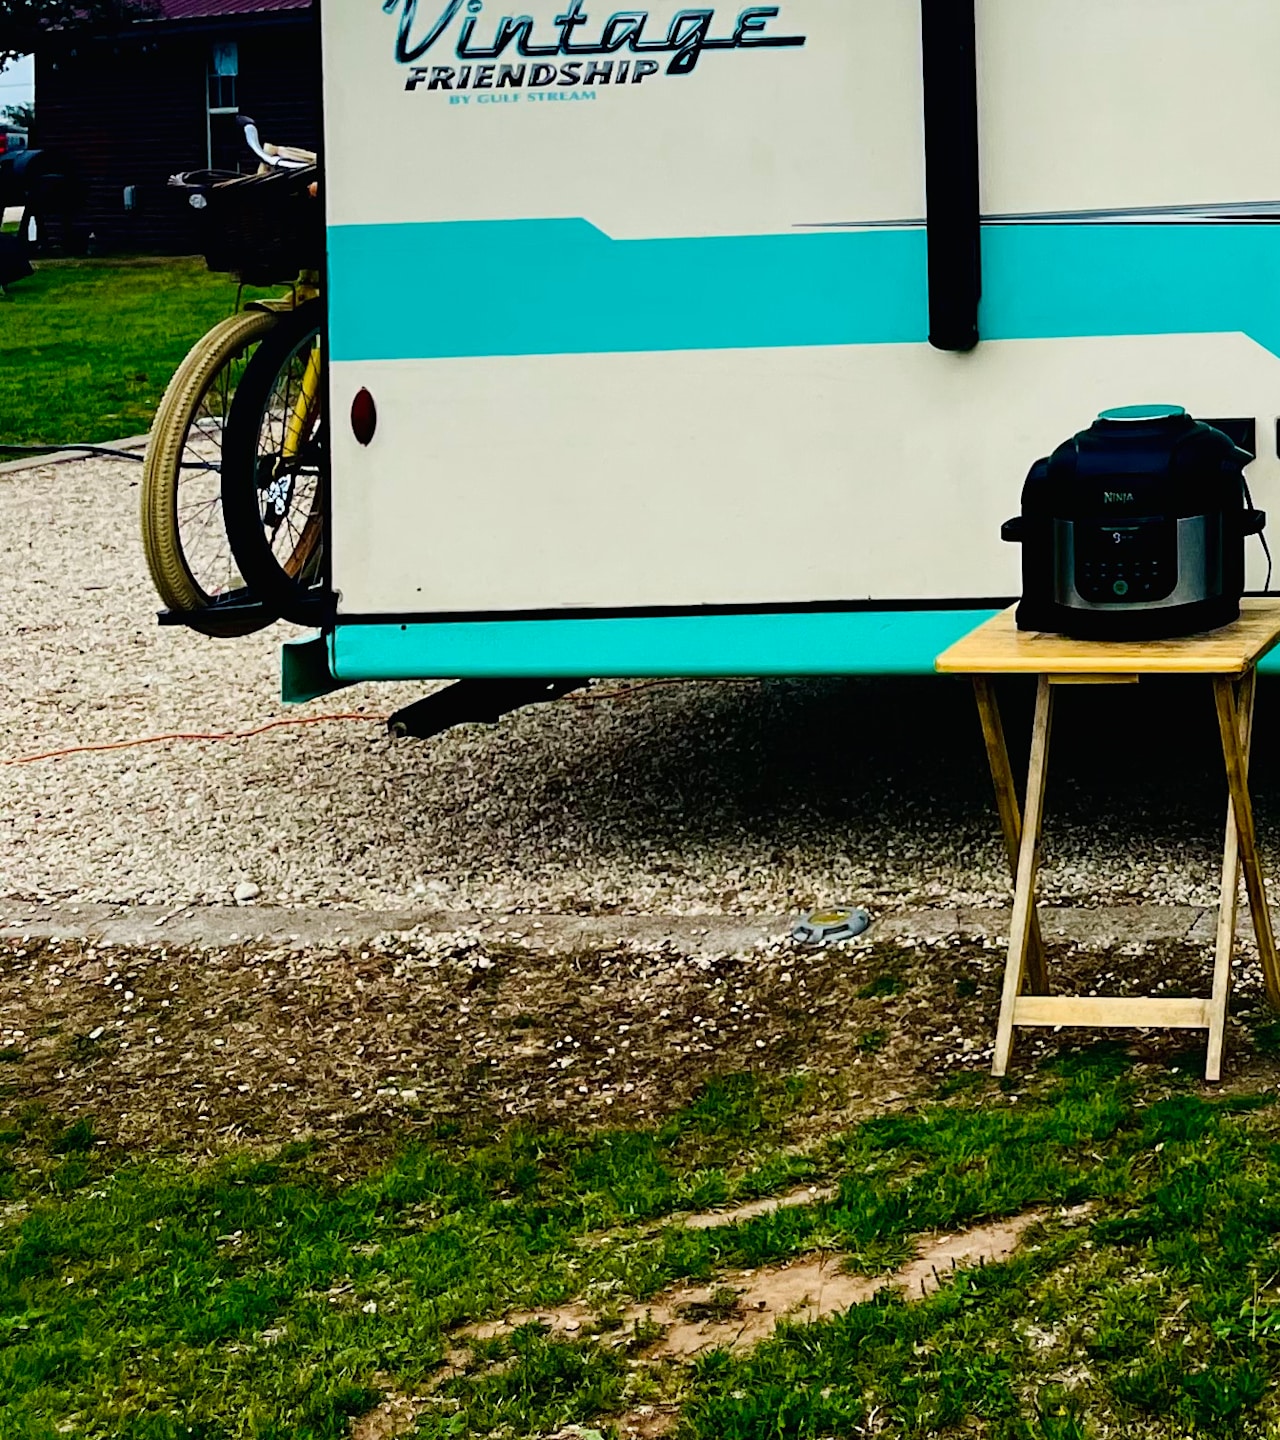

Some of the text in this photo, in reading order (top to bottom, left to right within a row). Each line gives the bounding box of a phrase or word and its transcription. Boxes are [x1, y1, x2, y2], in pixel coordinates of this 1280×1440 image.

[404, 60, 660, 91] FRIENDSHIP
[449, 90, 597, 105] BY GULF STREAM
[1104, 491, 1134, 504] NINJA
